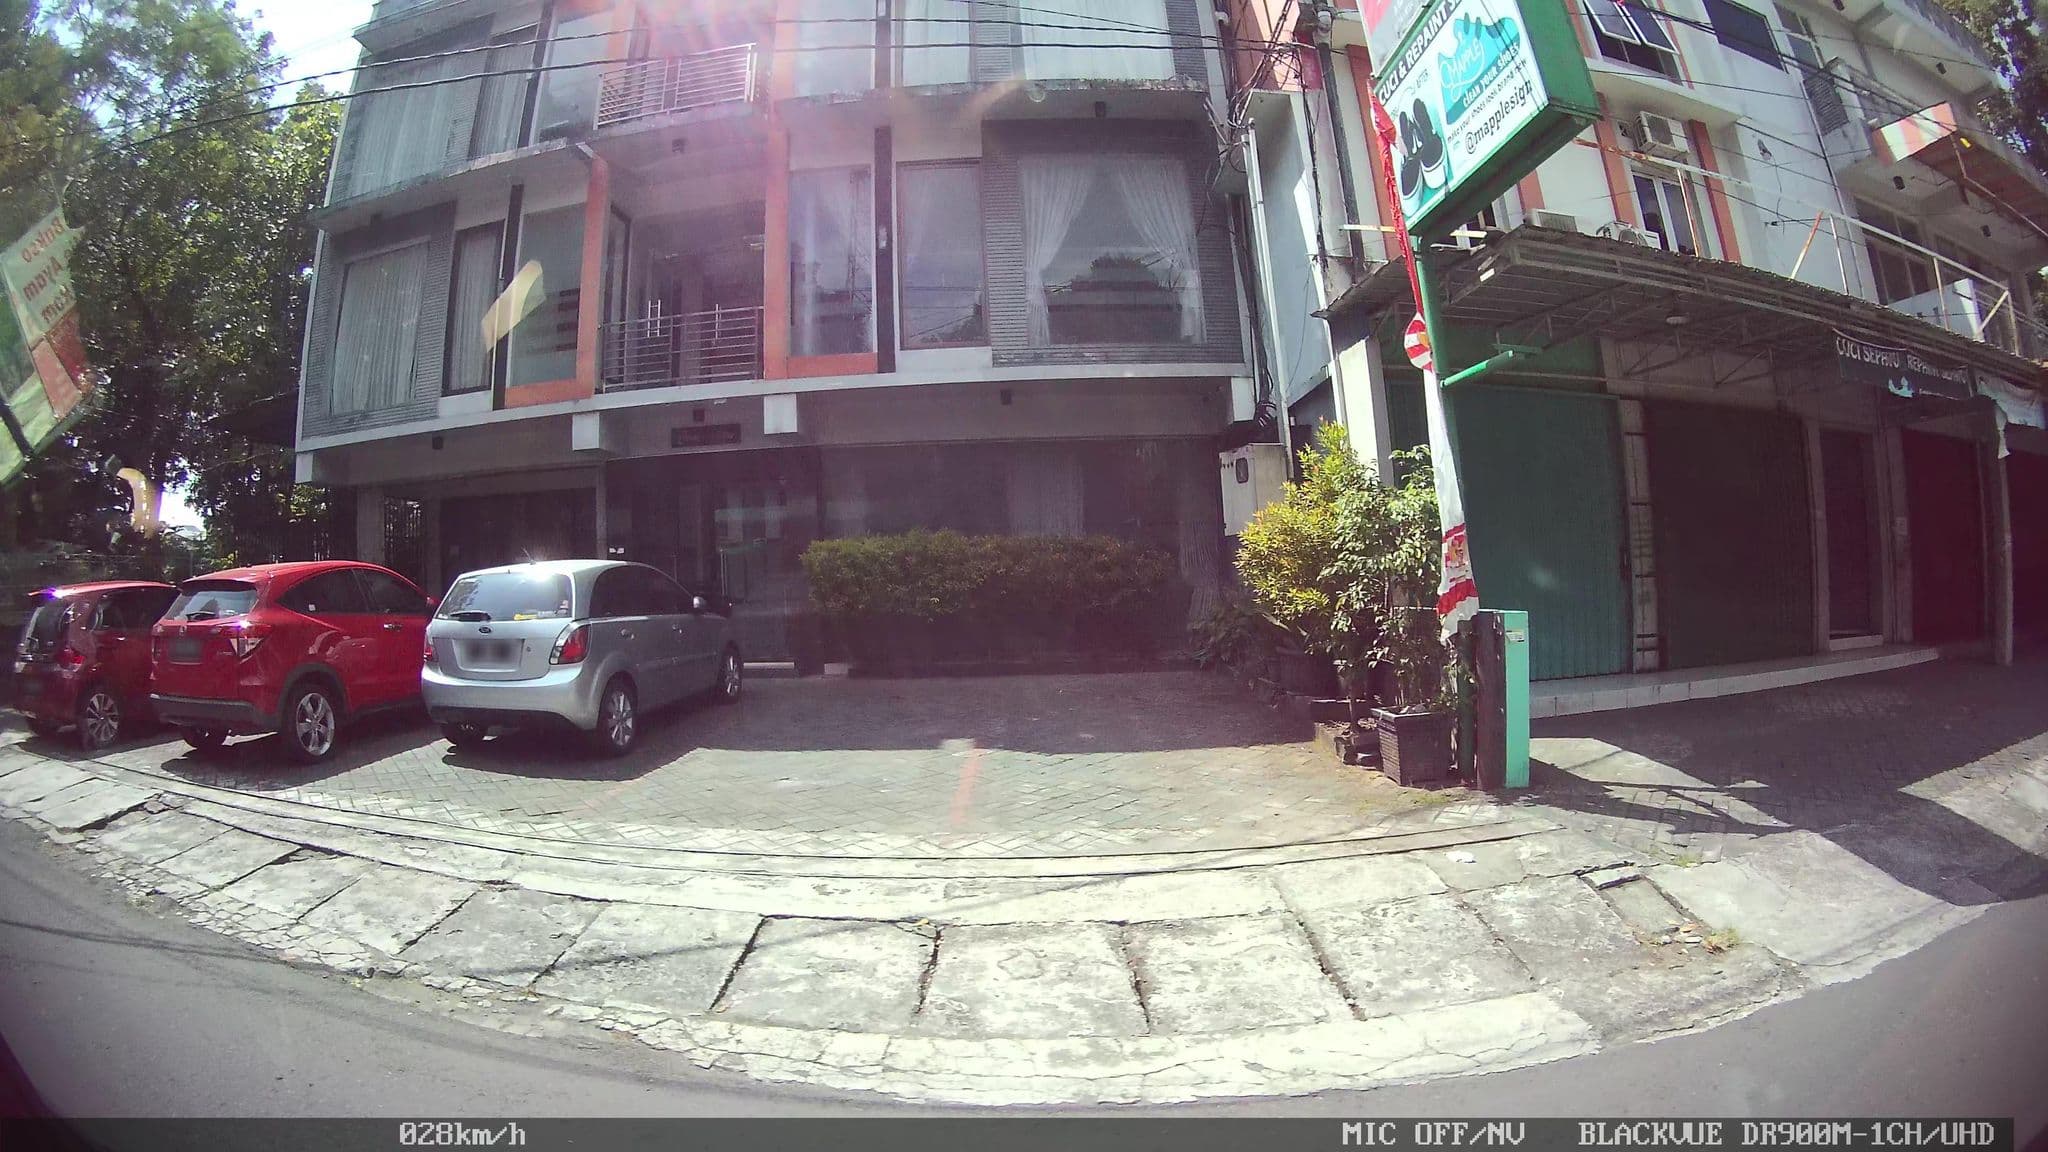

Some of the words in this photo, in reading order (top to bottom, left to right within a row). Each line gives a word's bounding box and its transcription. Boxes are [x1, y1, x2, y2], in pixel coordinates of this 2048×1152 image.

[1378, 70, 1400, 106] CUCI
[1405, 2, 1447, 69] REPAINT
[1464, 79, 1533, 155] @mapplesign
